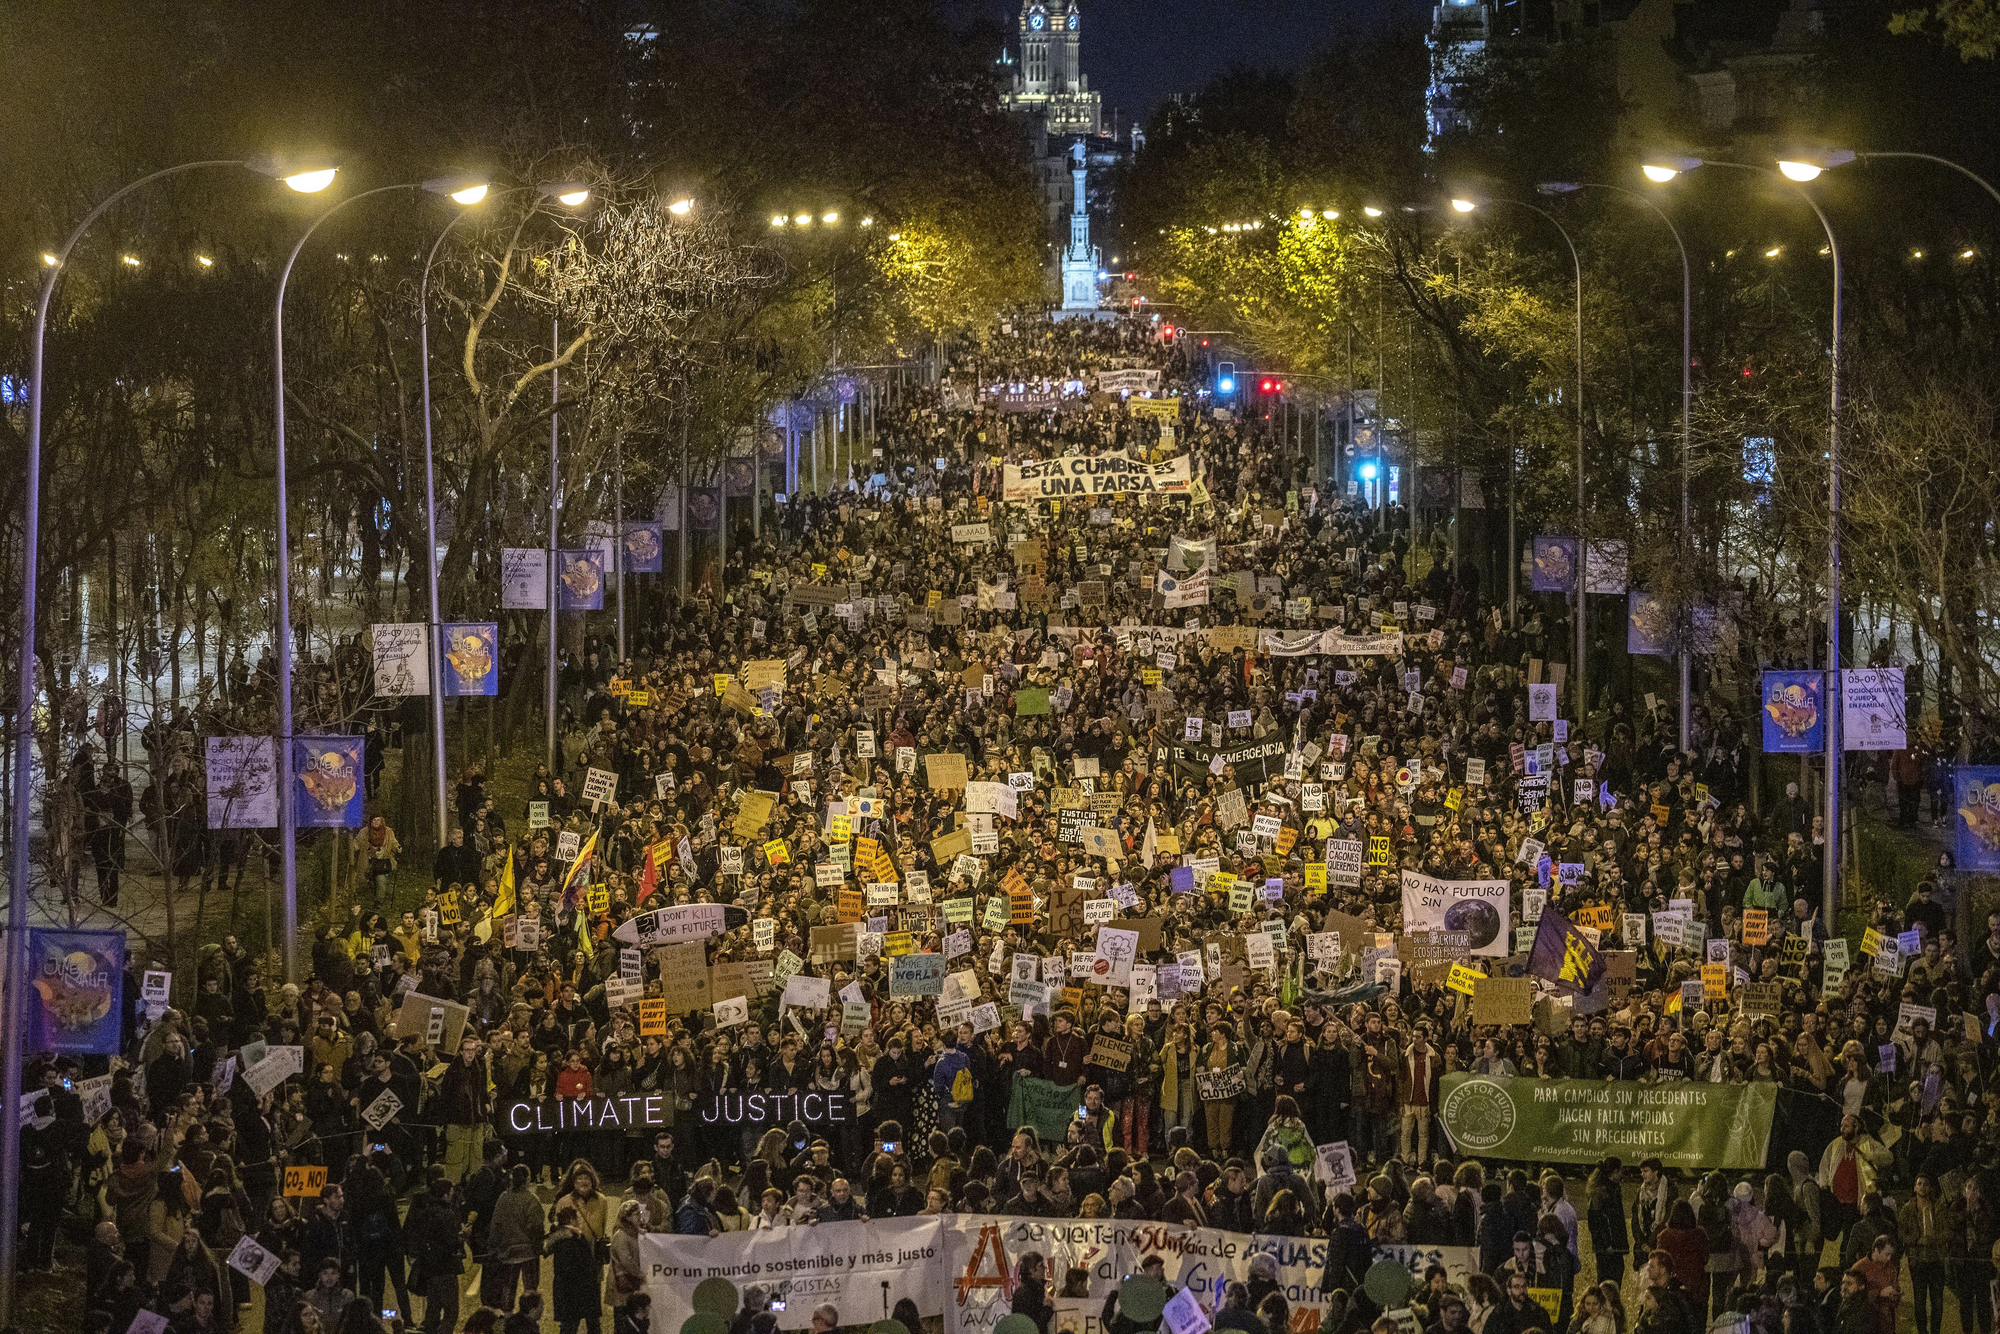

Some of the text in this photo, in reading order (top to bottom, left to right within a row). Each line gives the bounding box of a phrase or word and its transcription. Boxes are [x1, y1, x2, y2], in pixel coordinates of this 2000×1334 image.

[1020, 458, 1176, 479] ESTA CUMBRE ES
[1041, 477, 1086, 497] UNA
[1093, 475, 1156, 494] FARSA
[1220, 742, 1285, 763] EMERGENCIA
[588, 778, 607, 786] DROWN
[1061, 810, 1097, 819] JUSTICIA
[1327, 861, 1359, 872] QUEREMOS
[1403, 877, 1505, 897] NO HAY FUTURO
[1011, 903, 1032, 911] CHANGE
[1085, 901, 1113, 910] WE FIGTH
[1421, 897, 1442, 908] SIN
[442, 908, 460, 921] NO!
[692, 908, 716, 919] KILL
[899, 907, 927, 919] There's
[1085, 911, 1097, 919] FOR
[1598, 908, 1612, 923] NO!
[754, 920, 772, 929] THE RICH
[930, 919, 937, 929] B
[1745, 922, 1766, 930] CAN'T
[661, 927, 676, 936] OUR
[755, 929, 772, 938] POLLUTE
[622, 952, 639, 962] CLIMATE
[1830, 952, 1844, 960] OVER
[622, 962, 640, 970] CHANGE
[895, 969, 940, 980] WORLD
[1743, 1001, 1777, 1011] SCIENCE
[1094, 1036, 1132, 1053] SILENCE
[1092, 1054, 1126, 1069] OPTION
[1196, 1072, 1212, 1084] THE
[1200, 1081, 1246, 1100] CLOTHES
[1533, 1088, 1707, 1106] PARA CAMBIOS SIN PRECEDENTES
[509, 1094, 846, 1131] CLIMATE JUSTICE
[1448, 1085, 1511, 1130] FRIDAYS FOR FUTURE
[1559, 1108, 1674, 1126] HACEN FALTA MEDIDAS
[1461, 1131, 1498, 1144] MADRID
[1572, 1128, 1666, 1145] SIN PRECEDENTES
[1532, 1146, 1606, 1158] #FridaysForFuture
[1631, 1151, 1704, 1161] #YouthForClimate
[307, 1172, 327, 1192] NO!
[1052, 1225, 1125, 1246] vierten
[1210, 1237, 1237, 1259] de
[652, 1245, 936, 1278] Por un mundo sostenible y más justo
[1098, 1253, 1119, 1280] al
